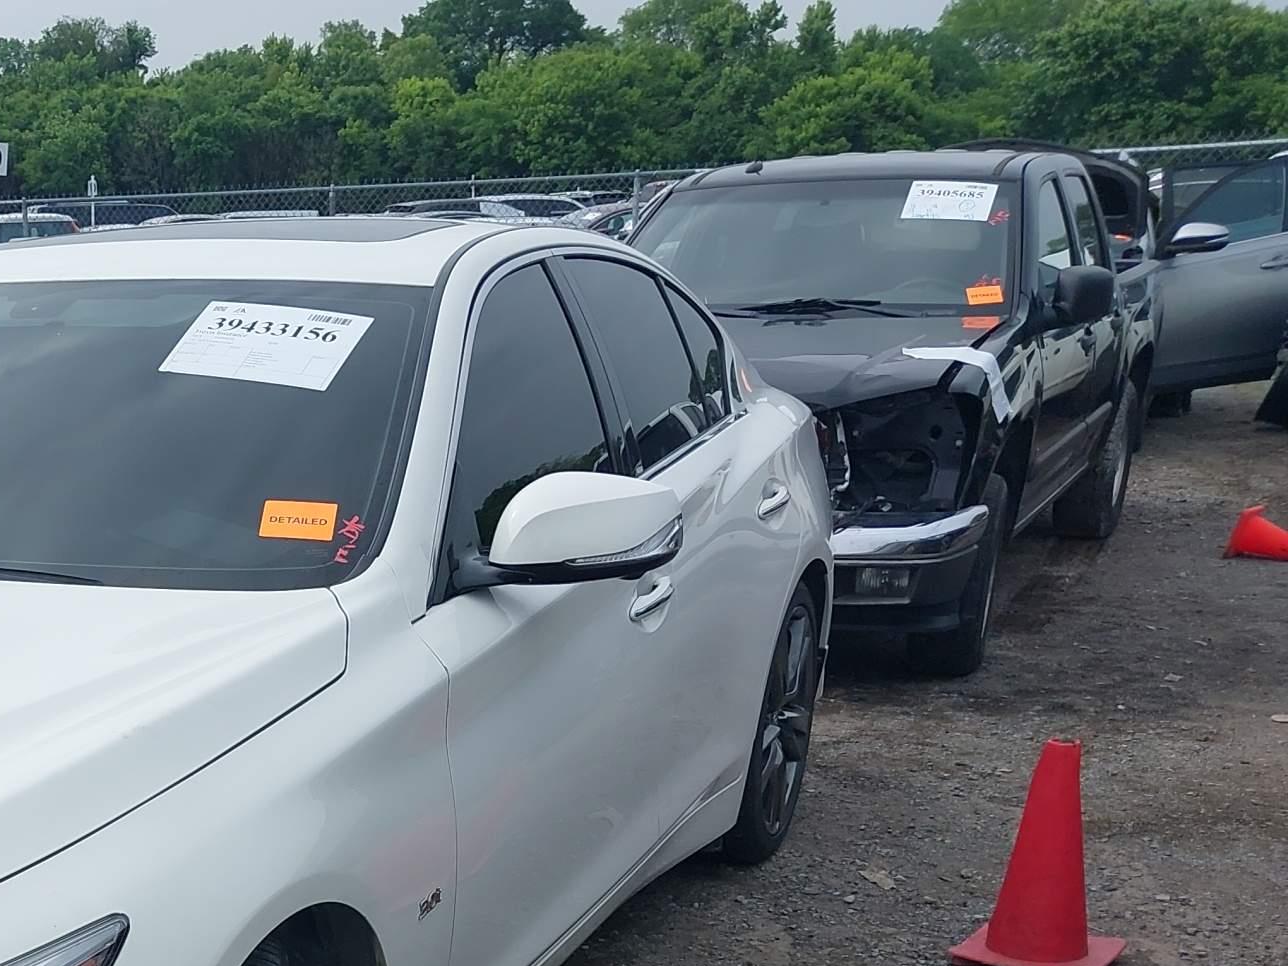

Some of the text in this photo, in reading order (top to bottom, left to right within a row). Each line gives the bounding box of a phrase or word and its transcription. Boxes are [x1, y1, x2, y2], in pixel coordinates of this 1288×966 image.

[918, 188, 985, 199] 39405685
[208, 317, 340, 343] 39433156
[268, 515, 328, 526] DETAILED
